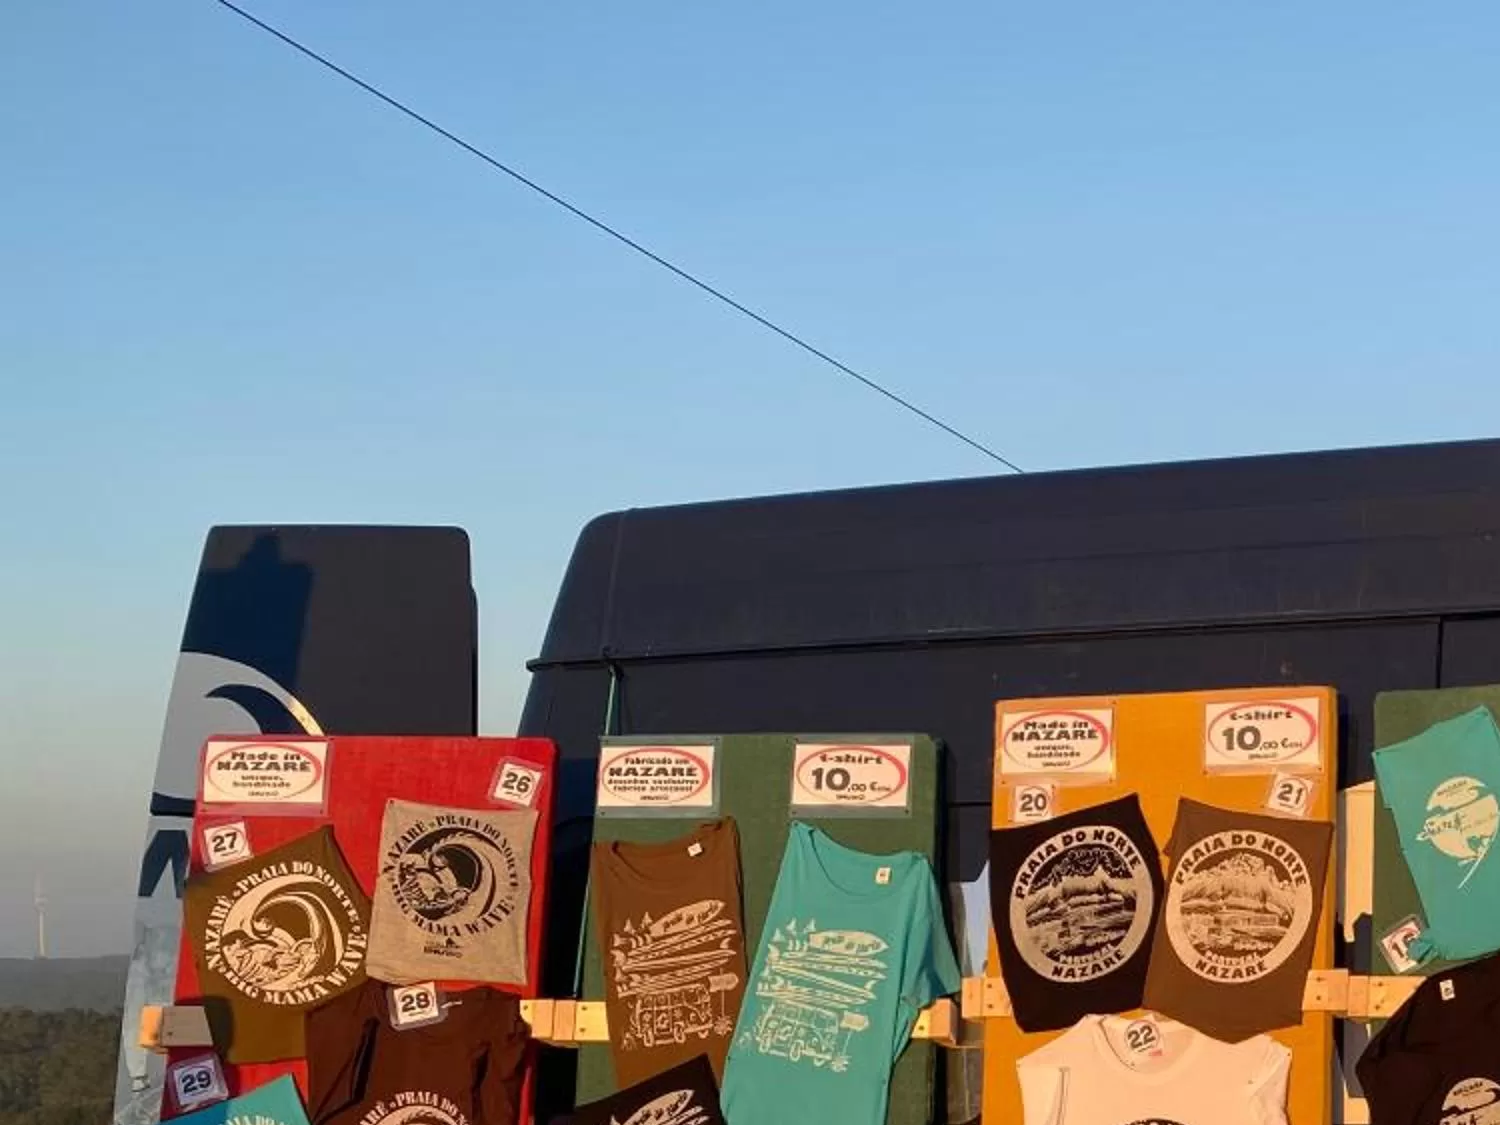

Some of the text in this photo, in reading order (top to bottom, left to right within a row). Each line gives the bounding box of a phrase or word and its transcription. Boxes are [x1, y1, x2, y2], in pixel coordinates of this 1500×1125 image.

[1024, 719, 1088, 729] Made in
[1229, 710, 1293, 720] t-shirt
[231, 752, 301, 761] Made in
[820, 754, 882, 764] t-shirt
[502, 772, 531, 793] 26
[1021, 793, 1047, 811] 20
[1278, 783, 1302, 804] 21
[212, 832, 237, 853] 27
[1015, 828, 1141, 900] PRAIA DO NORTE
[1176, 833, 1307, 887] PRAIA DO NORTE
[235, 862, 289, 893] PRAIA
[292, 861, 313, 873] DO
[263, 984, 329, 1004] MAMA
[325, 933, 367, 987] WAVE
[401, 991, 430, 1012] 28
[1128, 1025, 1156, 1049] 22
[182, 1070, 211, 1094] 29
